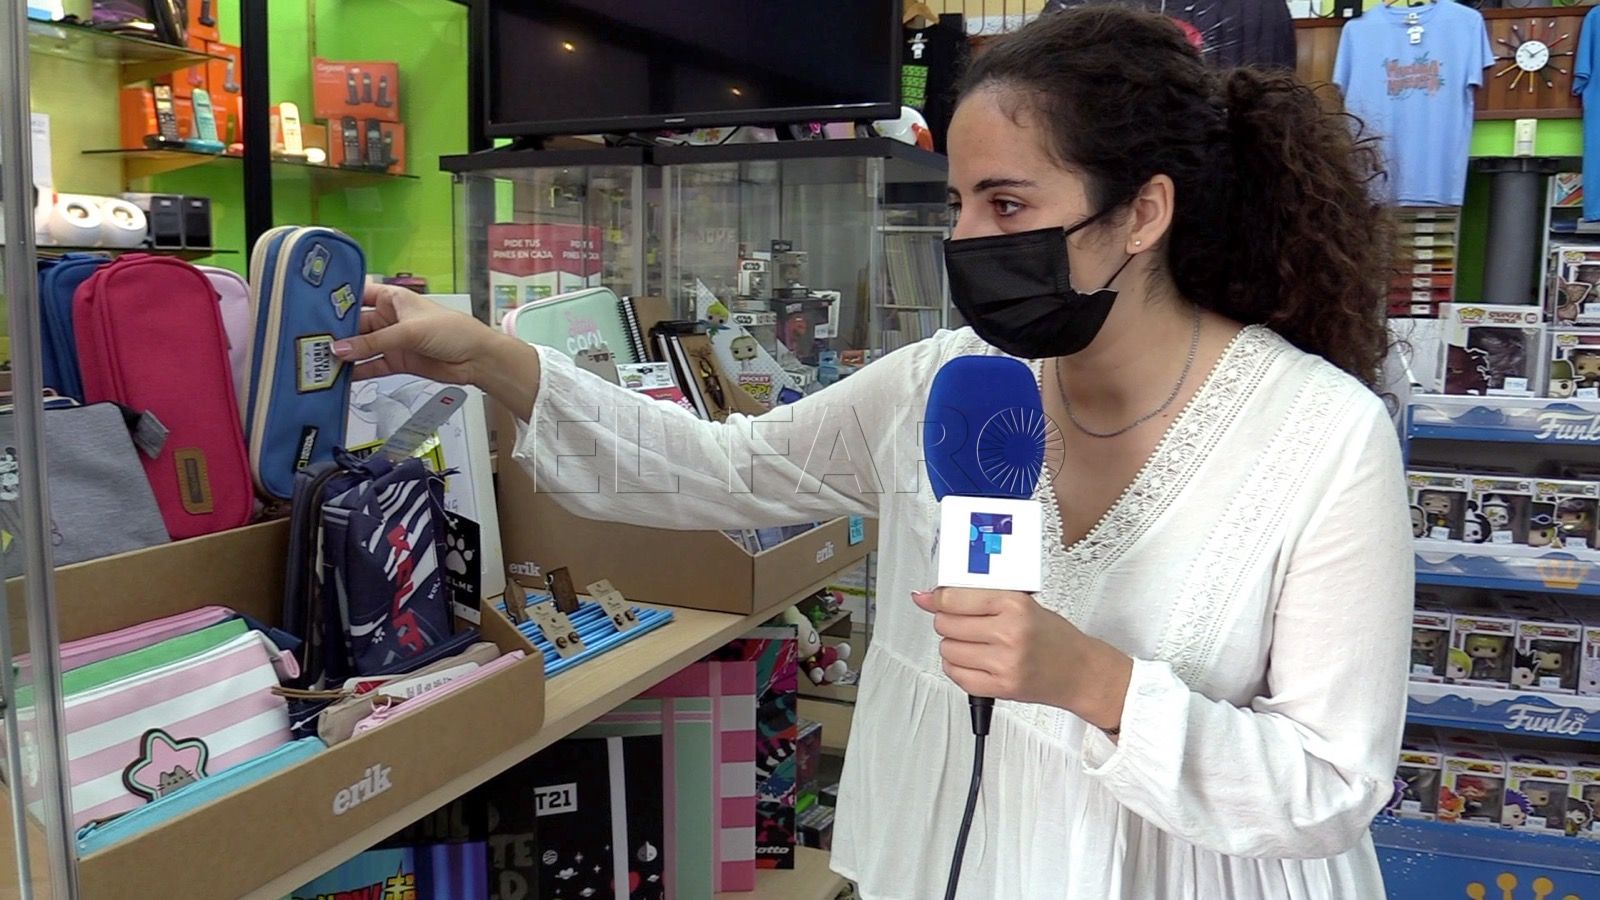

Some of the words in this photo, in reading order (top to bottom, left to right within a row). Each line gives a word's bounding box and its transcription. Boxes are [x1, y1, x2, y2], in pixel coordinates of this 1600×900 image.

[504, 239, 522, 248] PIDE
[525, 239, 541, 248] TUS
[493, 250, 516, 259] PINES
[518, 250, 529, 259] EN
[530, 250, 554, 259] CAJA
[740, 375, 770, 383] POCKET
[510, 561, 542, 577] erik
[1503, 703, 1585, 736] Funko
[332, 763, 393, 816] erik
[755, 846, 790, 854] otto
